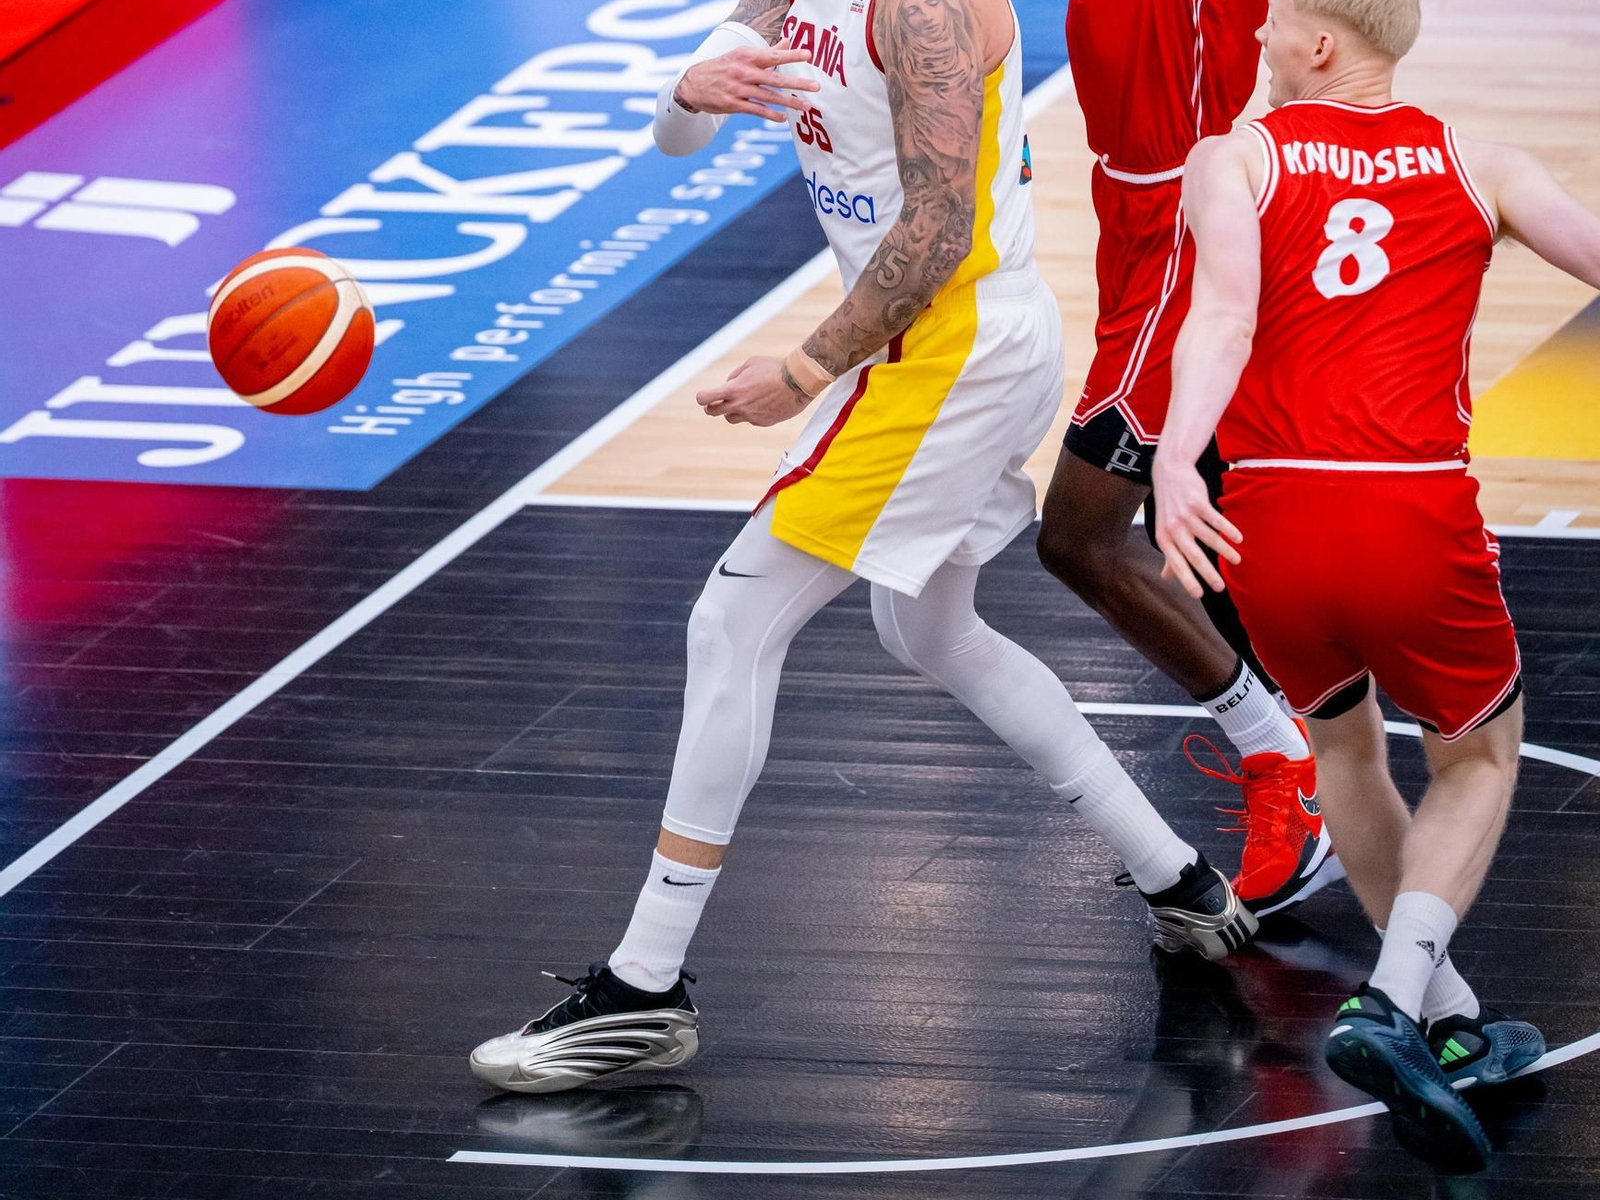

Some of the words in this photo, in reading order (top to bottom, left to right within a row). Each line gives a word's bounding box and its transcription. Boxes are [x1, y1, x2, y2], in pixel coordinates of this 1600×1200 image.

[805, 171, 876, 224] desa
[1282, 141, 1446, 185] KNUDSEN
[1311, 198, 1395, 300] 8
[327, 370, 473, 436] High
[449, 206, 709, 363] performing
